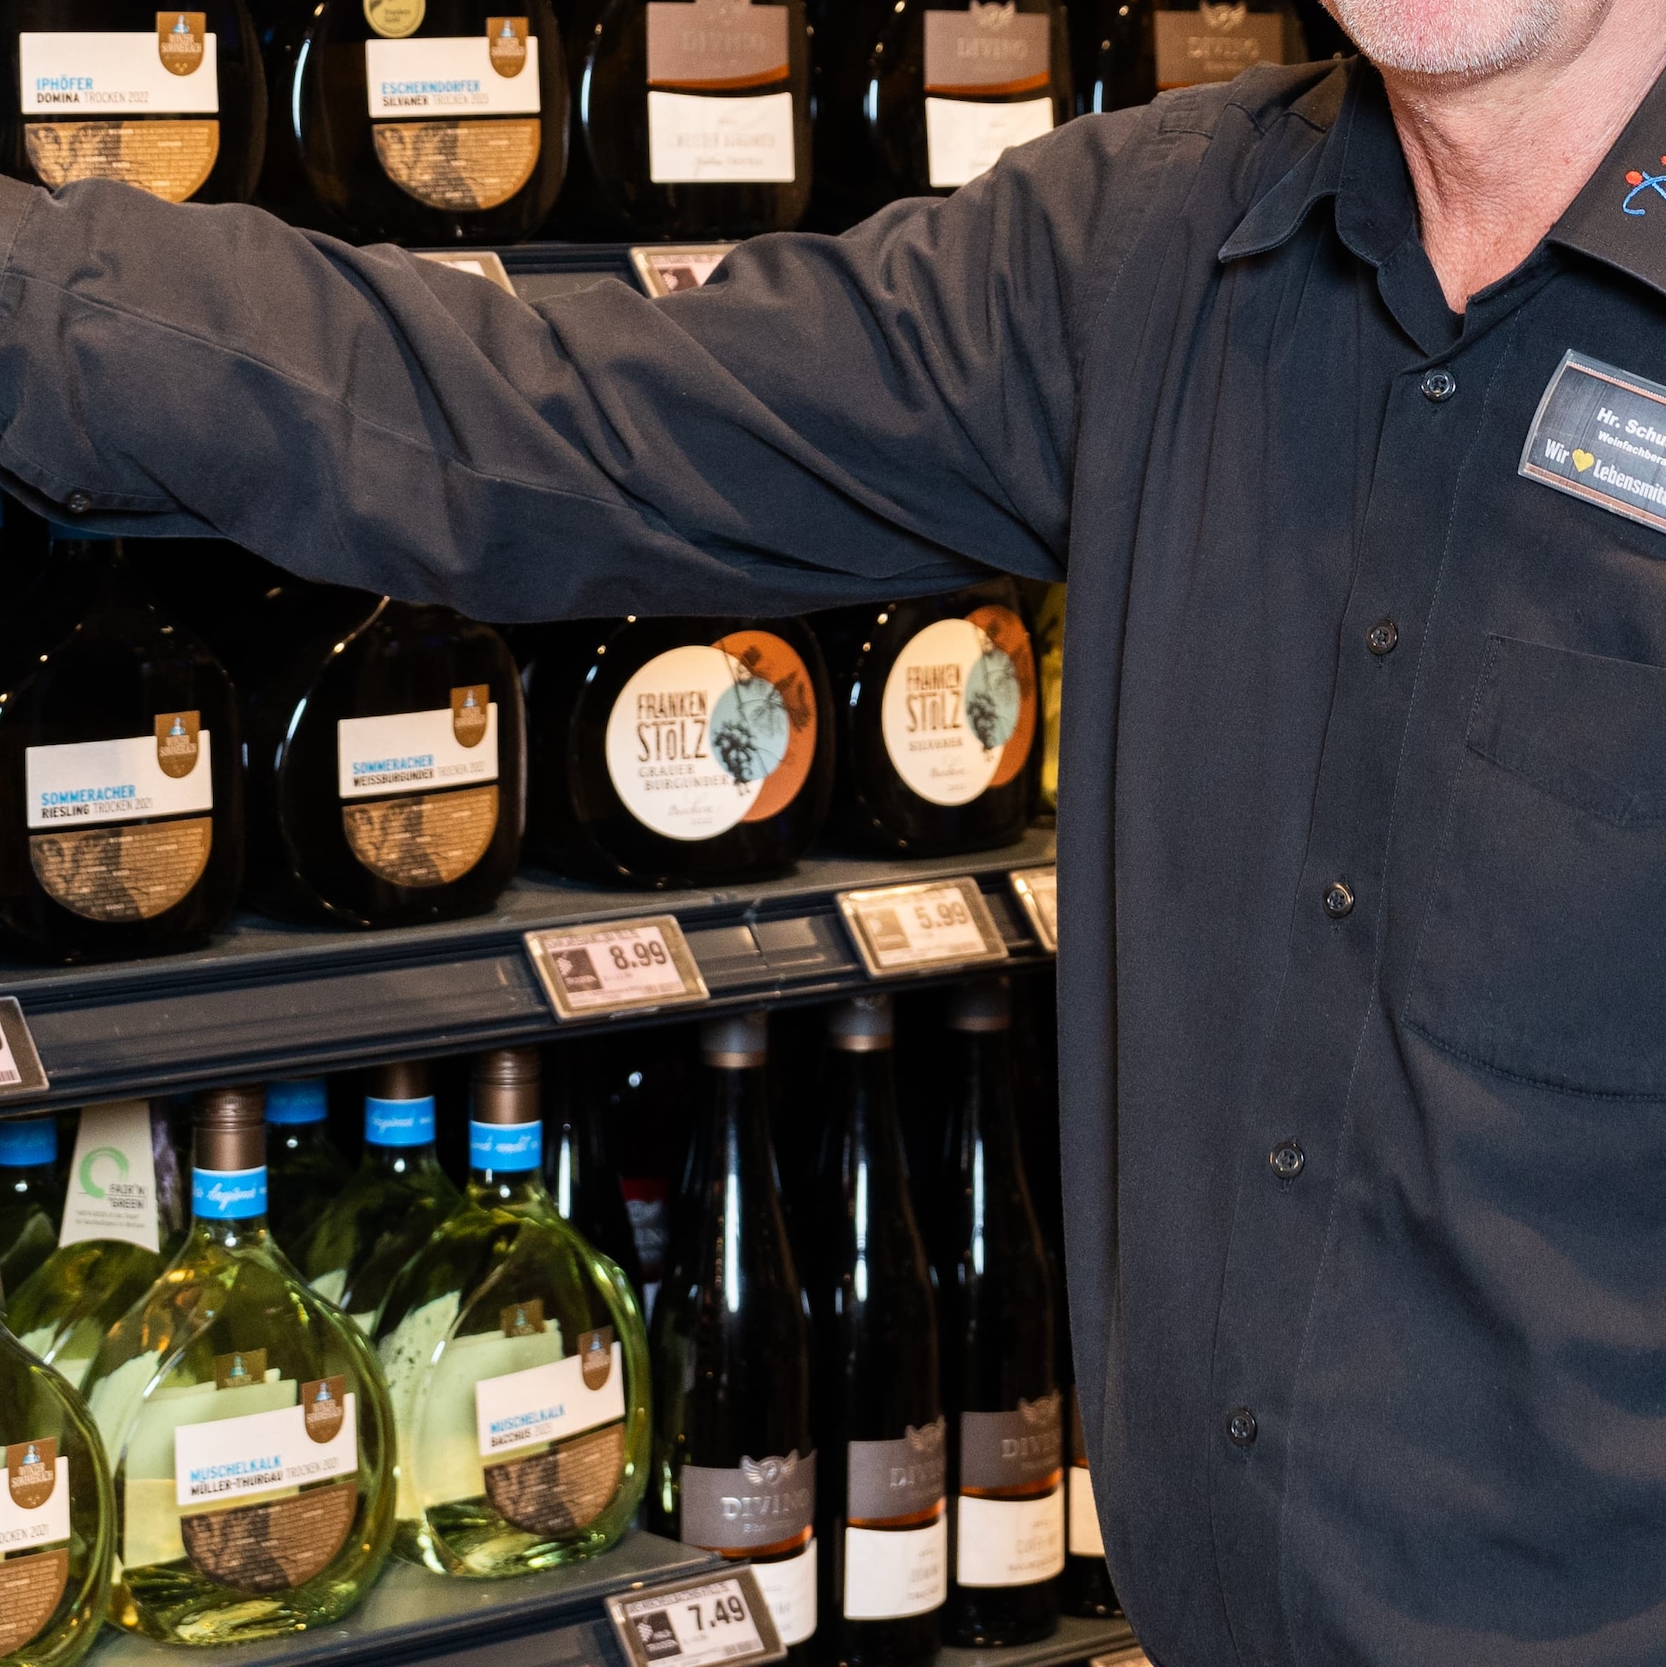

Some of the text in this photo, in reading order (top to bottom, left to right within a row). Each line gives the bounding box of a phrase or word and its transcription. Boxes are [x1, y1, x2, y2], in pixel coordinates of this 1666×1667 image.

[37, 75, 94, 91] IPHÖFER
[382, 78, 480, 94] ESCHERNDORFER
[37, 93, 80, 104] DOMINA
[382, 95, 429, 106] SILVANER
[1596, 407, 1621, 427] Hr.
[1545, 438, 1570, 465] Wir
[906, 664, 961, 692] FRANKEN
[638, 692, 707, 720] FRANKEN
[353, 754, 434, 774] SOMMERACHER
[638, 765, 695, 778] GRAUER
[353, 770, 434, 789] WEISSBURGUNDER
[644, 776, 729, 793] BURGUNDER
[41, 785, 135, 805] SOMMERACHER
[41, 803, 90, 819] RIESLING
[914, 900, 969, 932] 5.99
[612, 940, 668, 972] 8.99
[490, 1406, 565, 1433] MUSCHELKALK
[190, 1456, 282, 1482] MUSCHELKALK
[190, 1470, 283, 1497] MÜLLER-THURGAU
[686, 1596, 746, 1630] 7.49
